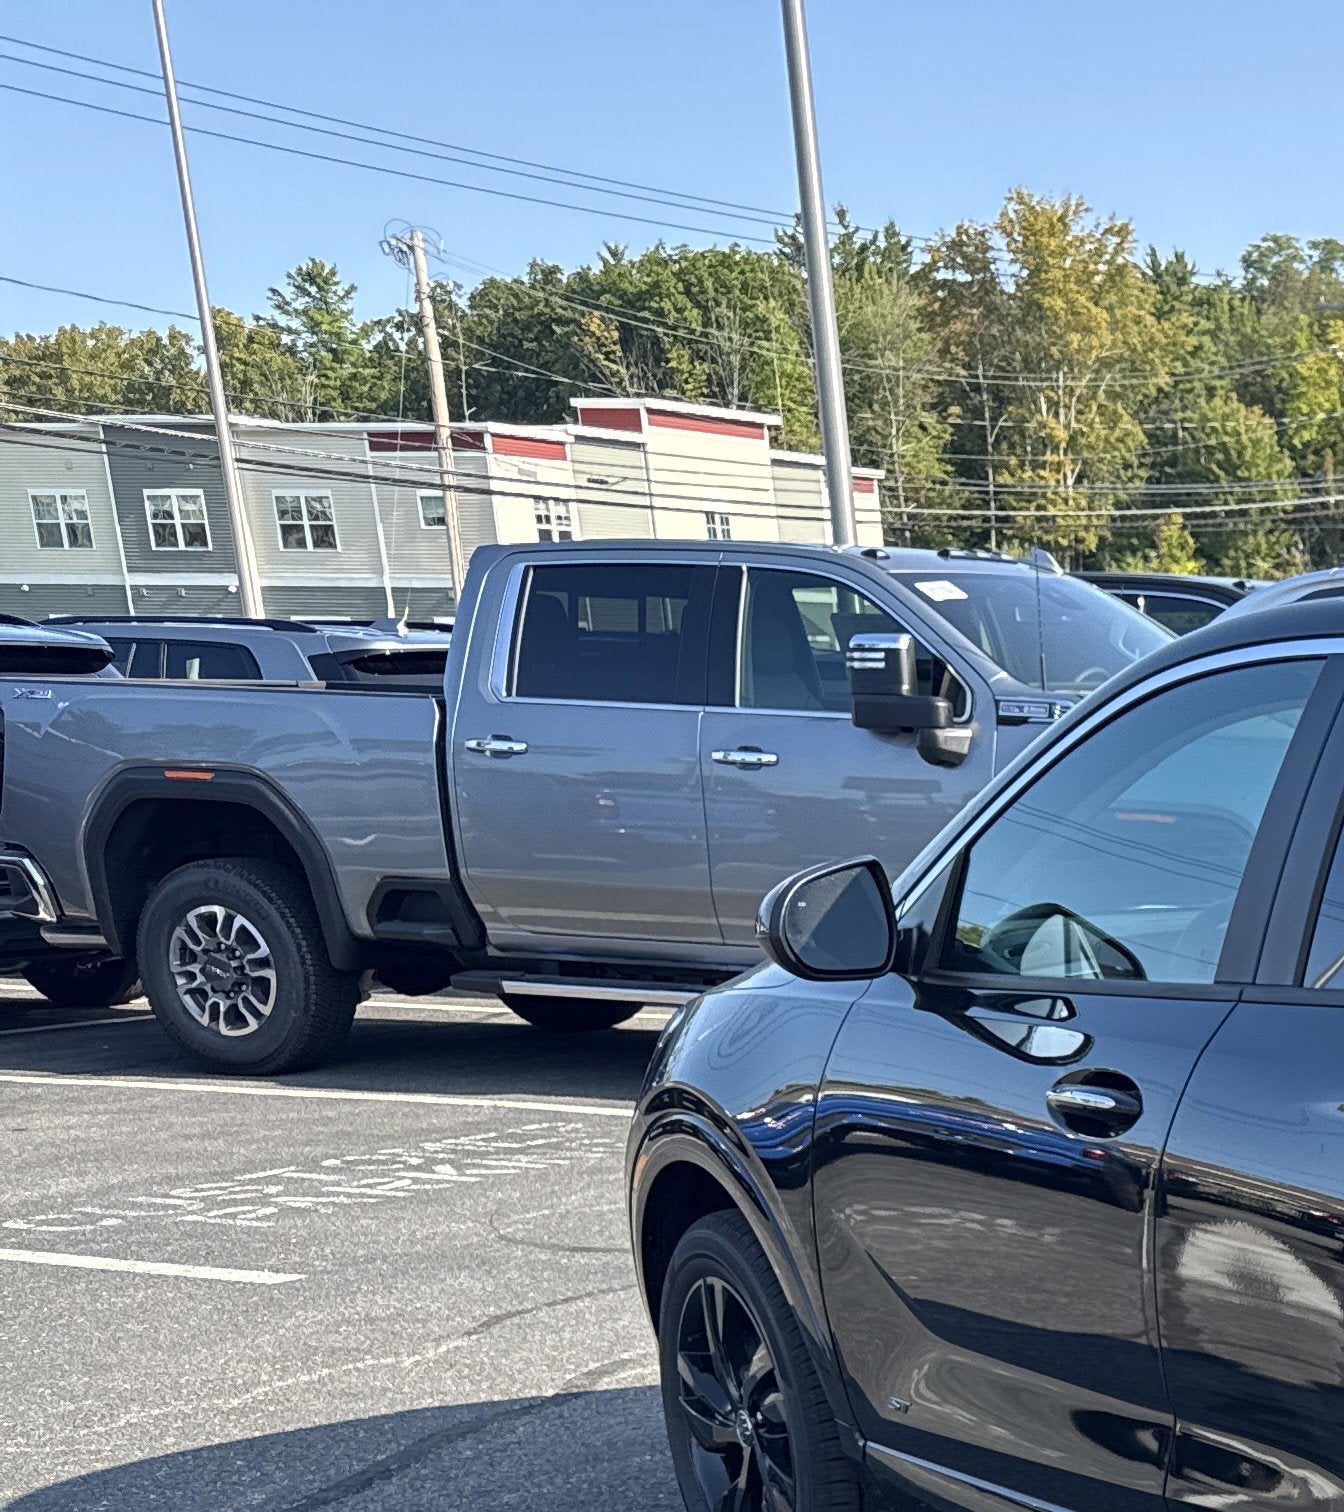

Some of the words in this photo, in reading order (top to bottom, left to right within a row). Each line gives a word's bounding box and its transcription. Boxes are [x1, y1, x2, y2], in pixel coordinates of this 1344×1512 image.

[3, 1121, 585, 1231] CUSTOMER
[178, 1139, 626, 1227] PARKING
[887, 1396, 913, 1414] ST
